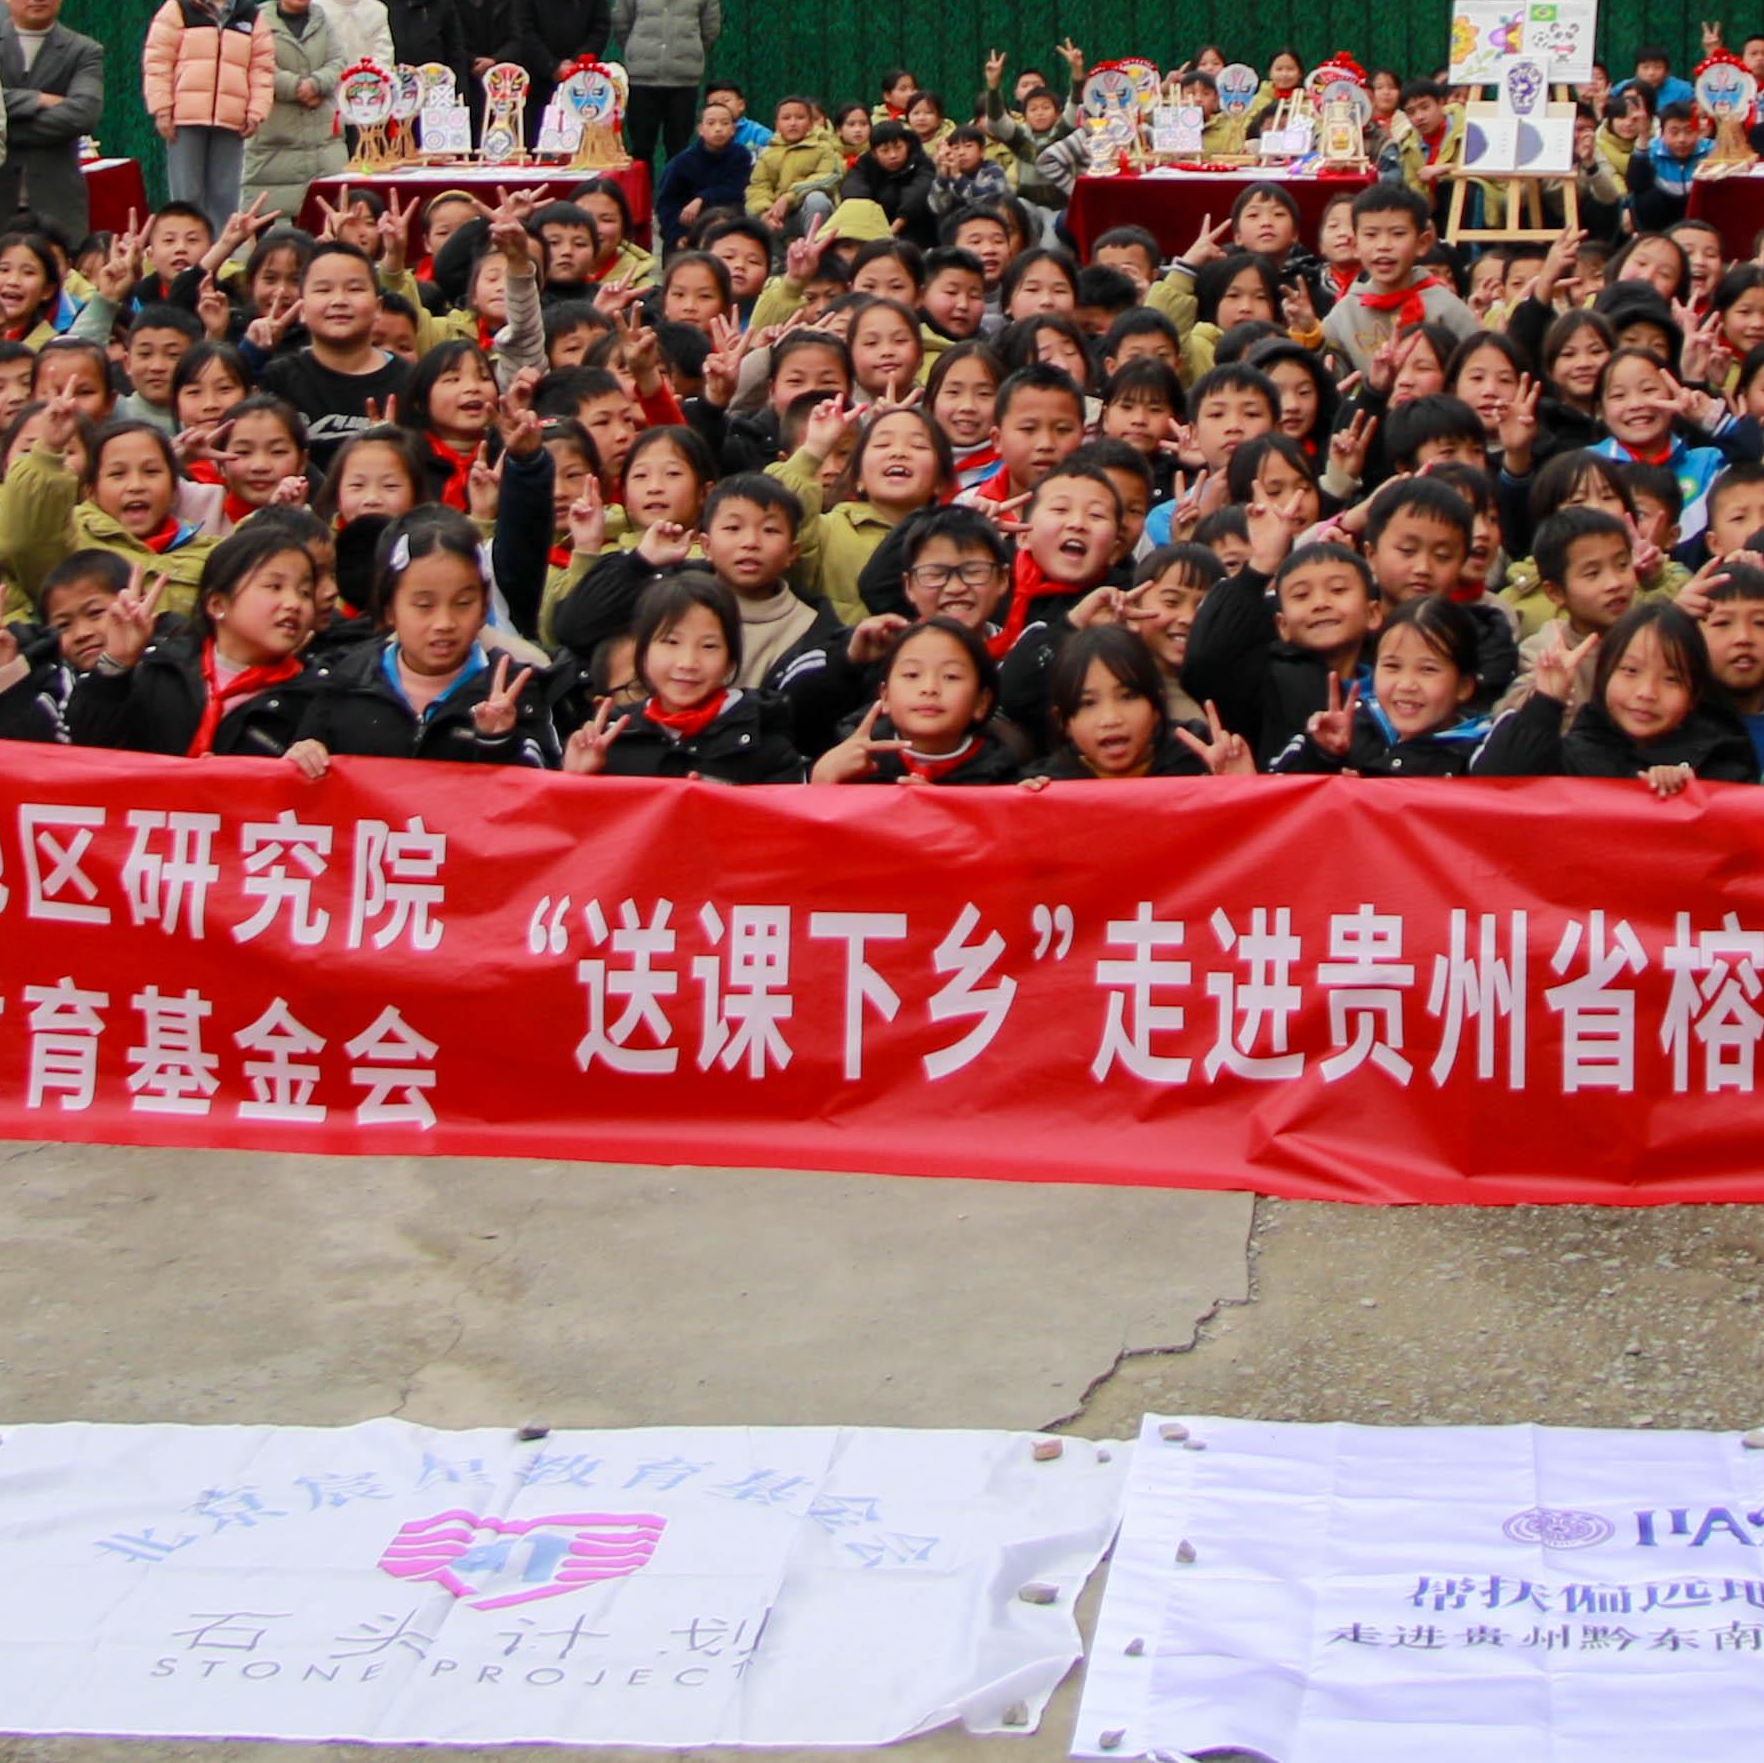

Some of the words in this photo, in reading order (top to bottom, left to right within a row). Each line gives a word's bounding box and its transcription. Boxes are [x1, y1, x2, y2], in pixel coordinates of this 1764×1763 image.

[172, 1606, 774, 1662] 石头计划
[149, 1655, 386, 1684] STONE
[429, 1657, 757, 1688] PROJECT
